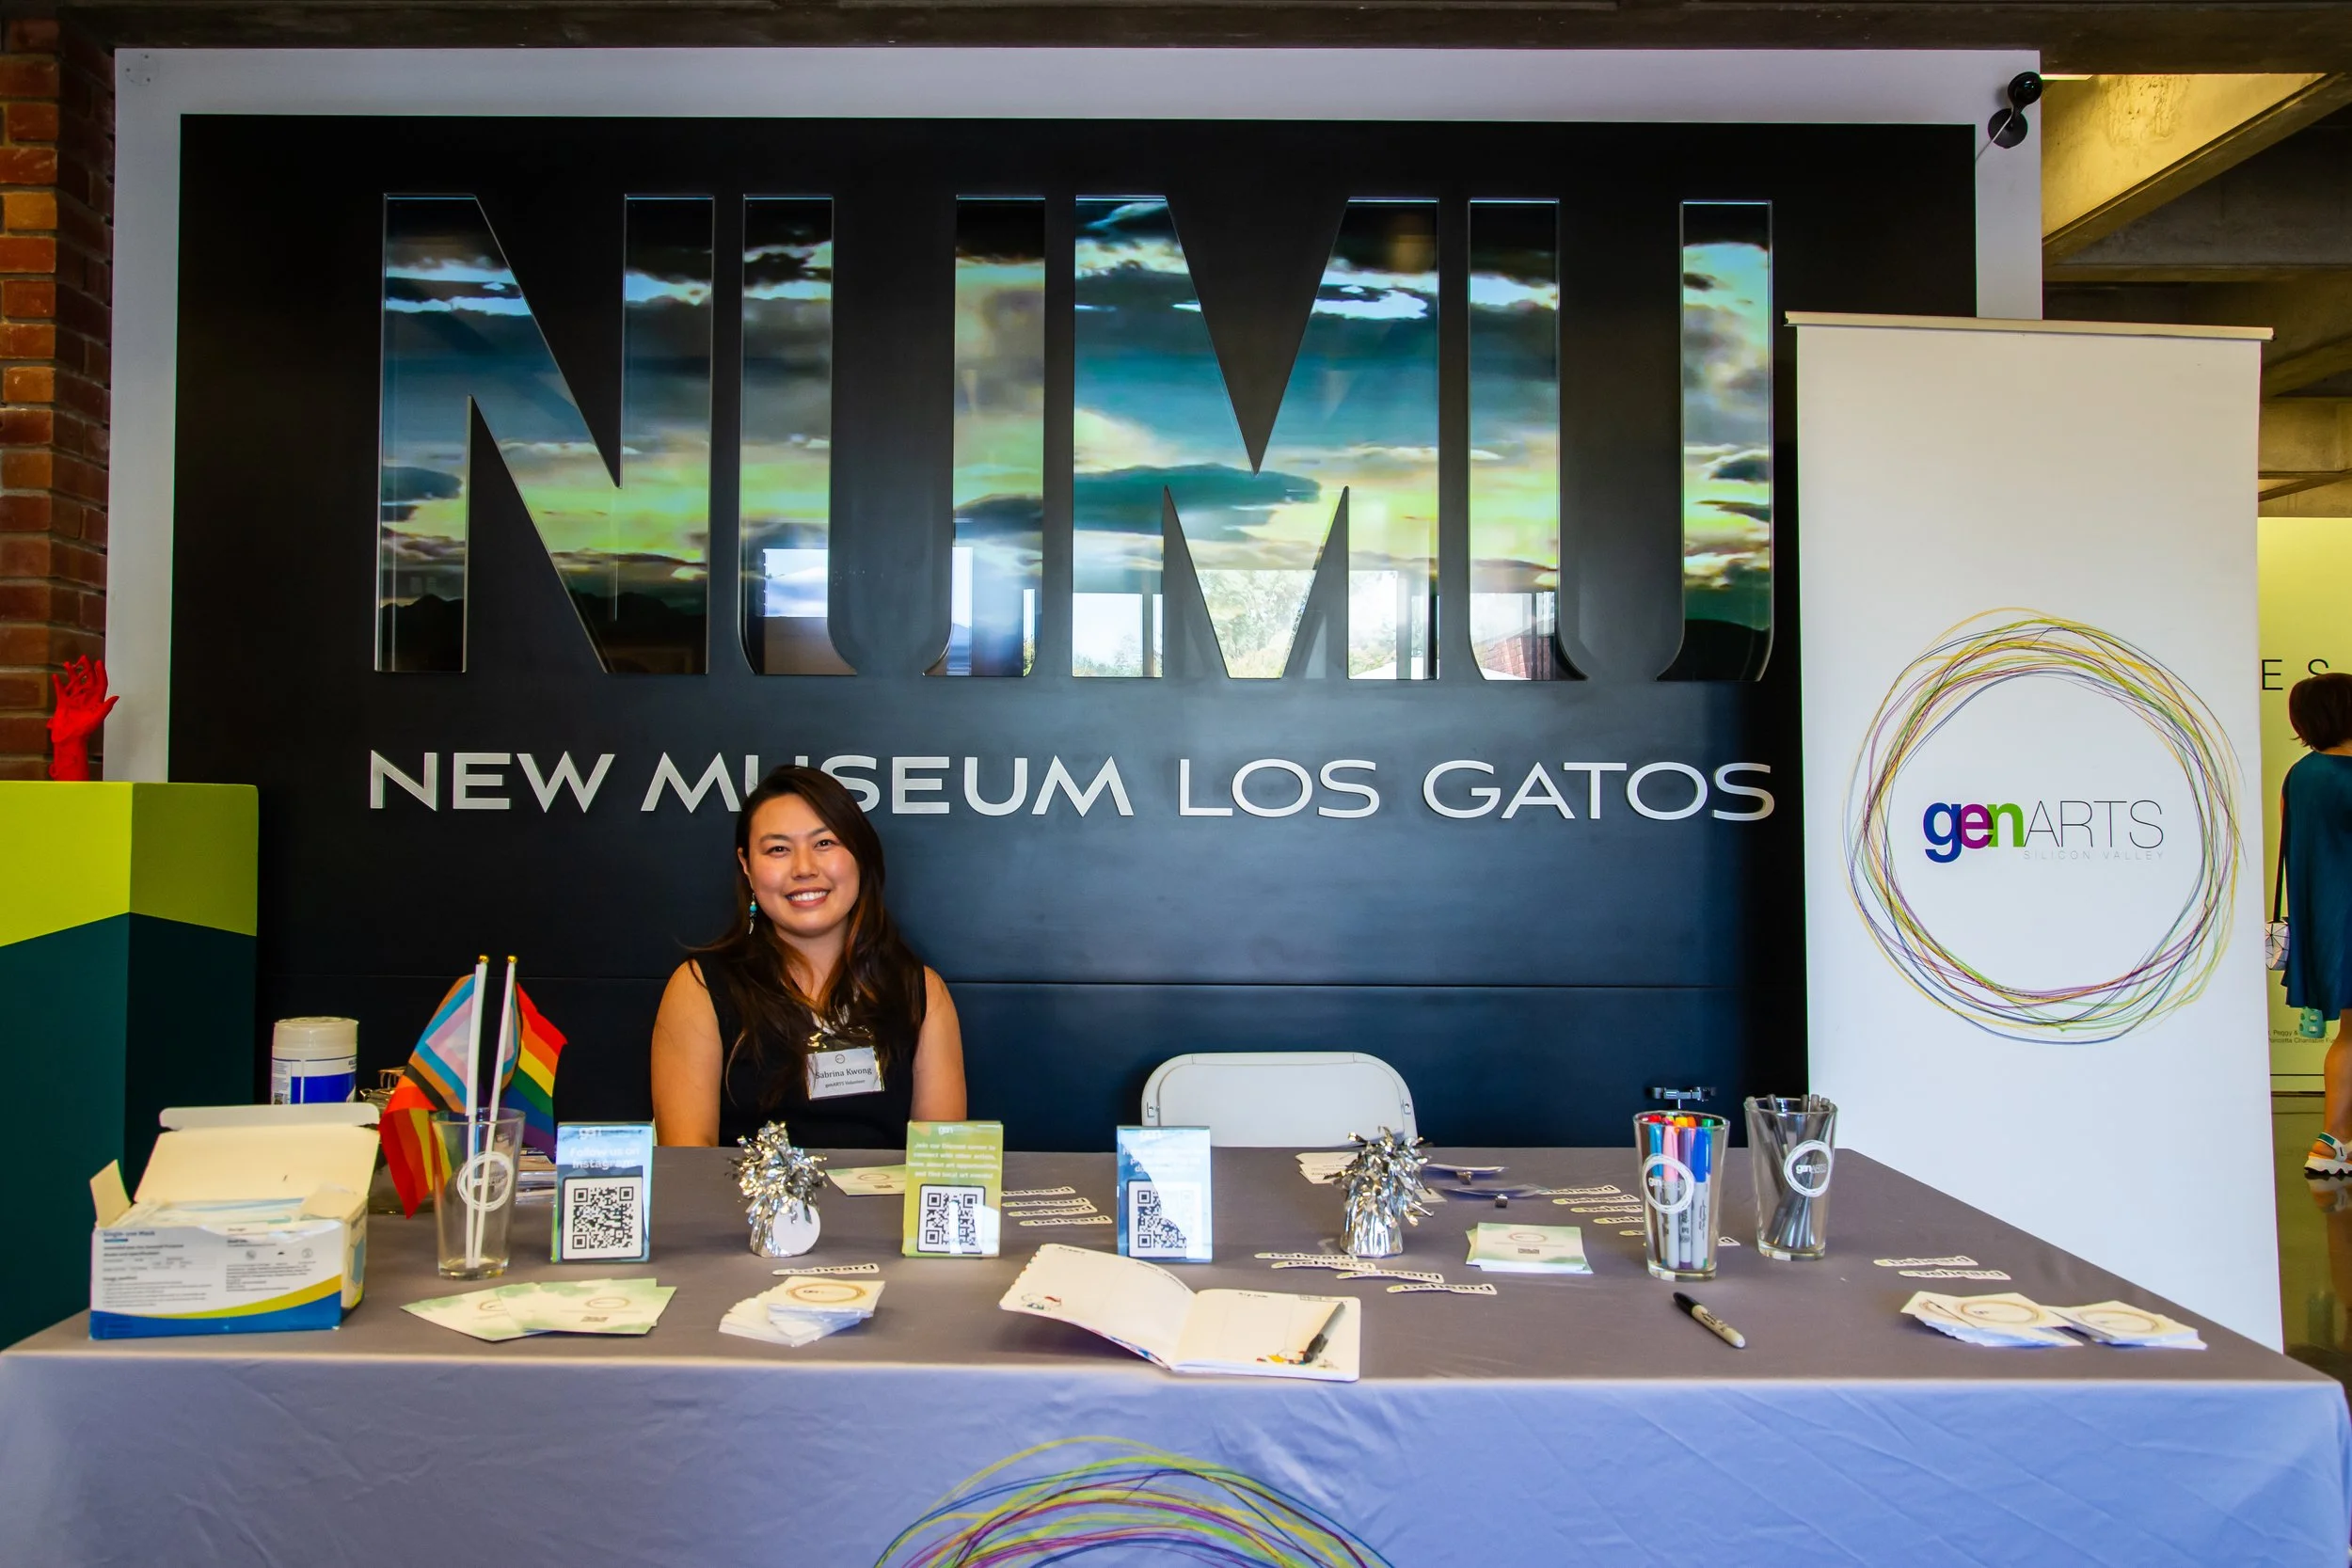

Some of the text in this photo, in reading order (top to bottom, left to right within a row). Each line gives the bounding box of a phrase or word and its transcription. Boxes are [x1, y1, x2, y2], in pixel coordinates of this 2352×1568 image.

[374, 193, 1773, 681] NUMU
[370, 751, 615, 814] NEW
[1179, 758, 1381, 819] LOS
[1422, 759, 1775, 823] GATOS
[1922, 800, 2165, 863] genARTS
[2024, 849, 2165, 861] SILICON VALLEY
[816, 1068, 872, 1080] Sabrina Kwong
[570, 1147, 607, 1157] Follow
[625, 1147, 640, 1155] on
